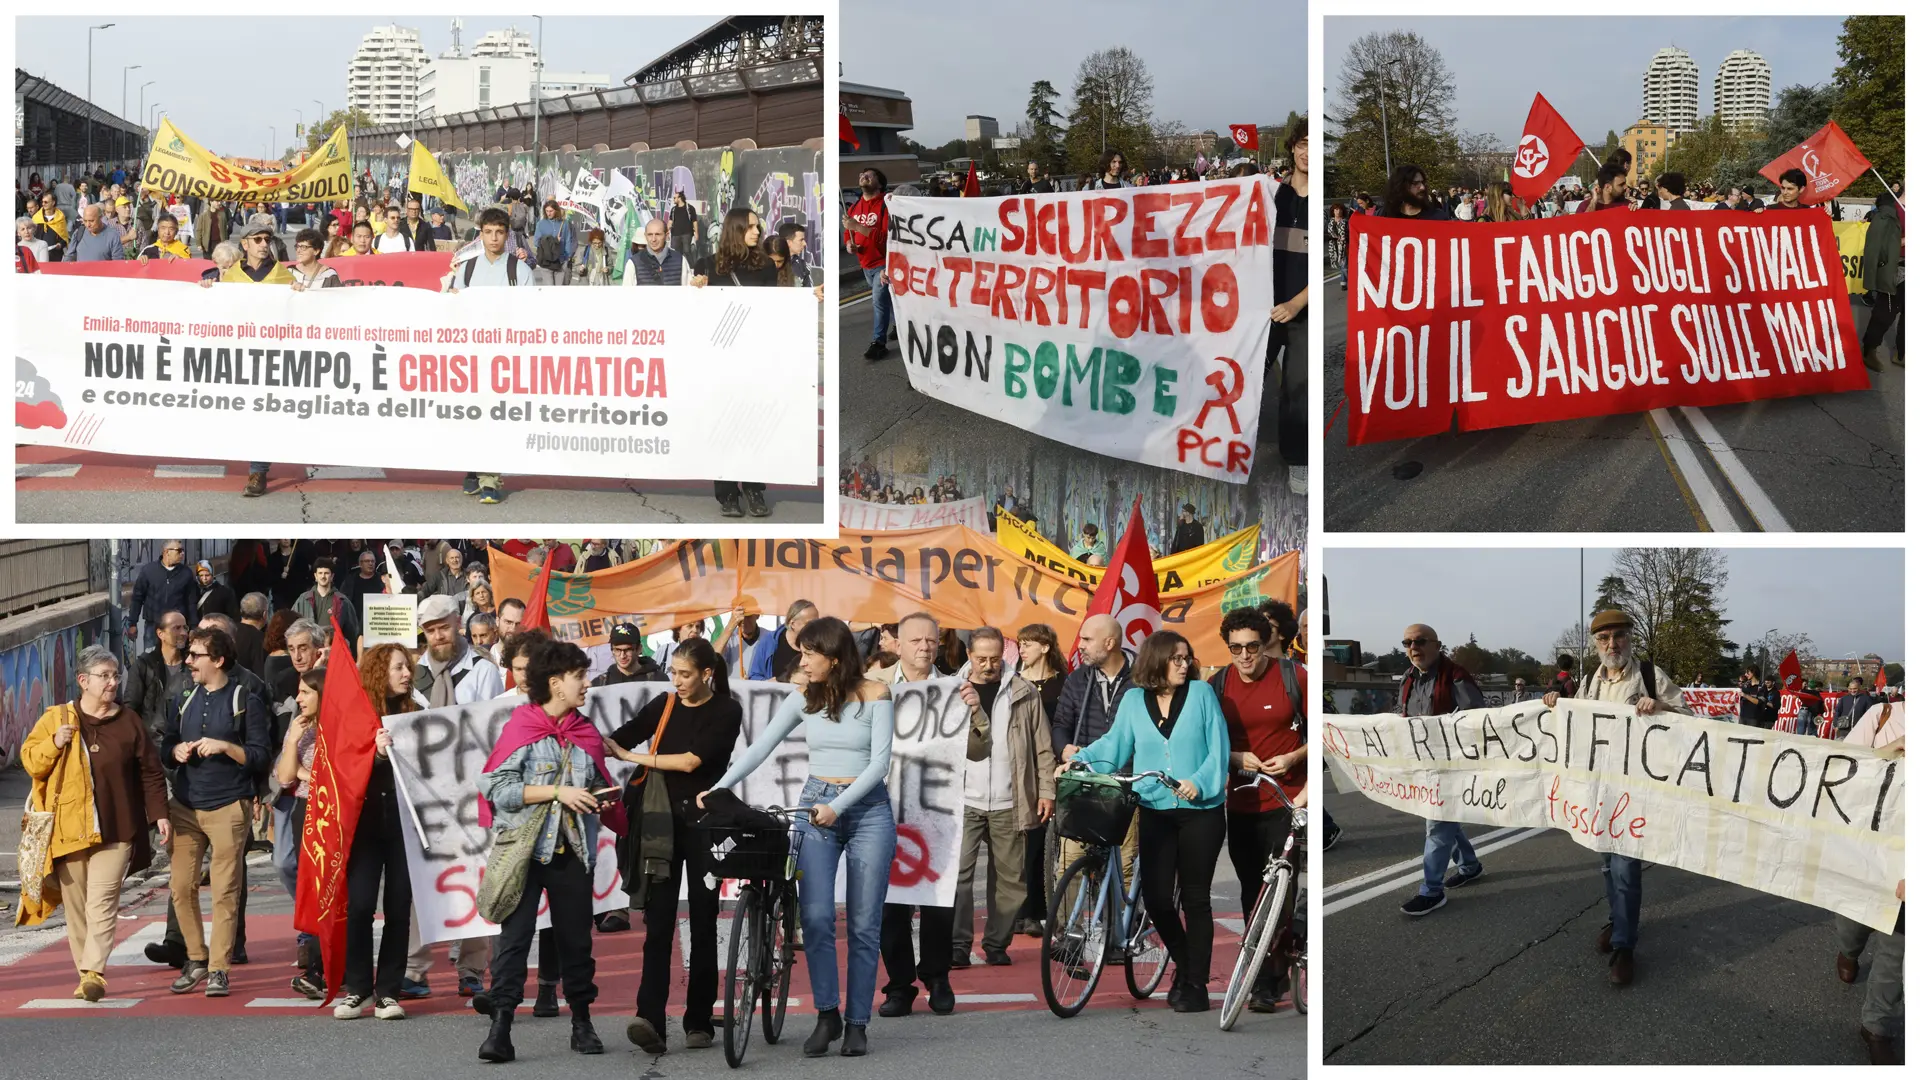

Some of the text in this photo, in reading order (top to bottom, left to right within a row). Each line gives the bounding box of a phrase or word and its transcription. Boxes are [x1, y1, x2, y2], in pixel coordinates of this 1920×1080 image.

[145, 162, 256, 201] CONSUMO
[286, 172, 350, 201] SUOLO
[973, 226, 997, 253] IN
[998, 180, 1270, 264] SICUREZZA
[942, 255, 1239, 340] TERRITORIO
[1357, 224, 1829, 312] NOI IL FANGO SUGLI STIVALI
[83, 315, 665, 346] Emilia-Romagna: regione più colpita da eventi estremi nel 2023 (dati ArpaE) e anche nel 2024
[1357, 297, 1847, 416] VOI IL SANGUE SULLE MANI
[84, 335, 668, 399] NON È MALTEMPO, È CRISI CLIMATICA
[908, 319, 1178, 418] NON BOMBE
[81, 386, 669, 427] e concezione sbagliata dell'uso del territorio
[525, 431, 671, 455] #piovonoproteste
[1176, 428, 1252, 476] PCR
[920, 546, 1005, 600] per
[1361, 726, 1388, 757] AI
[1407, 707, 1899, 832] RIGASSIFICATORI
[1462, 774, 1507, 810] dal
